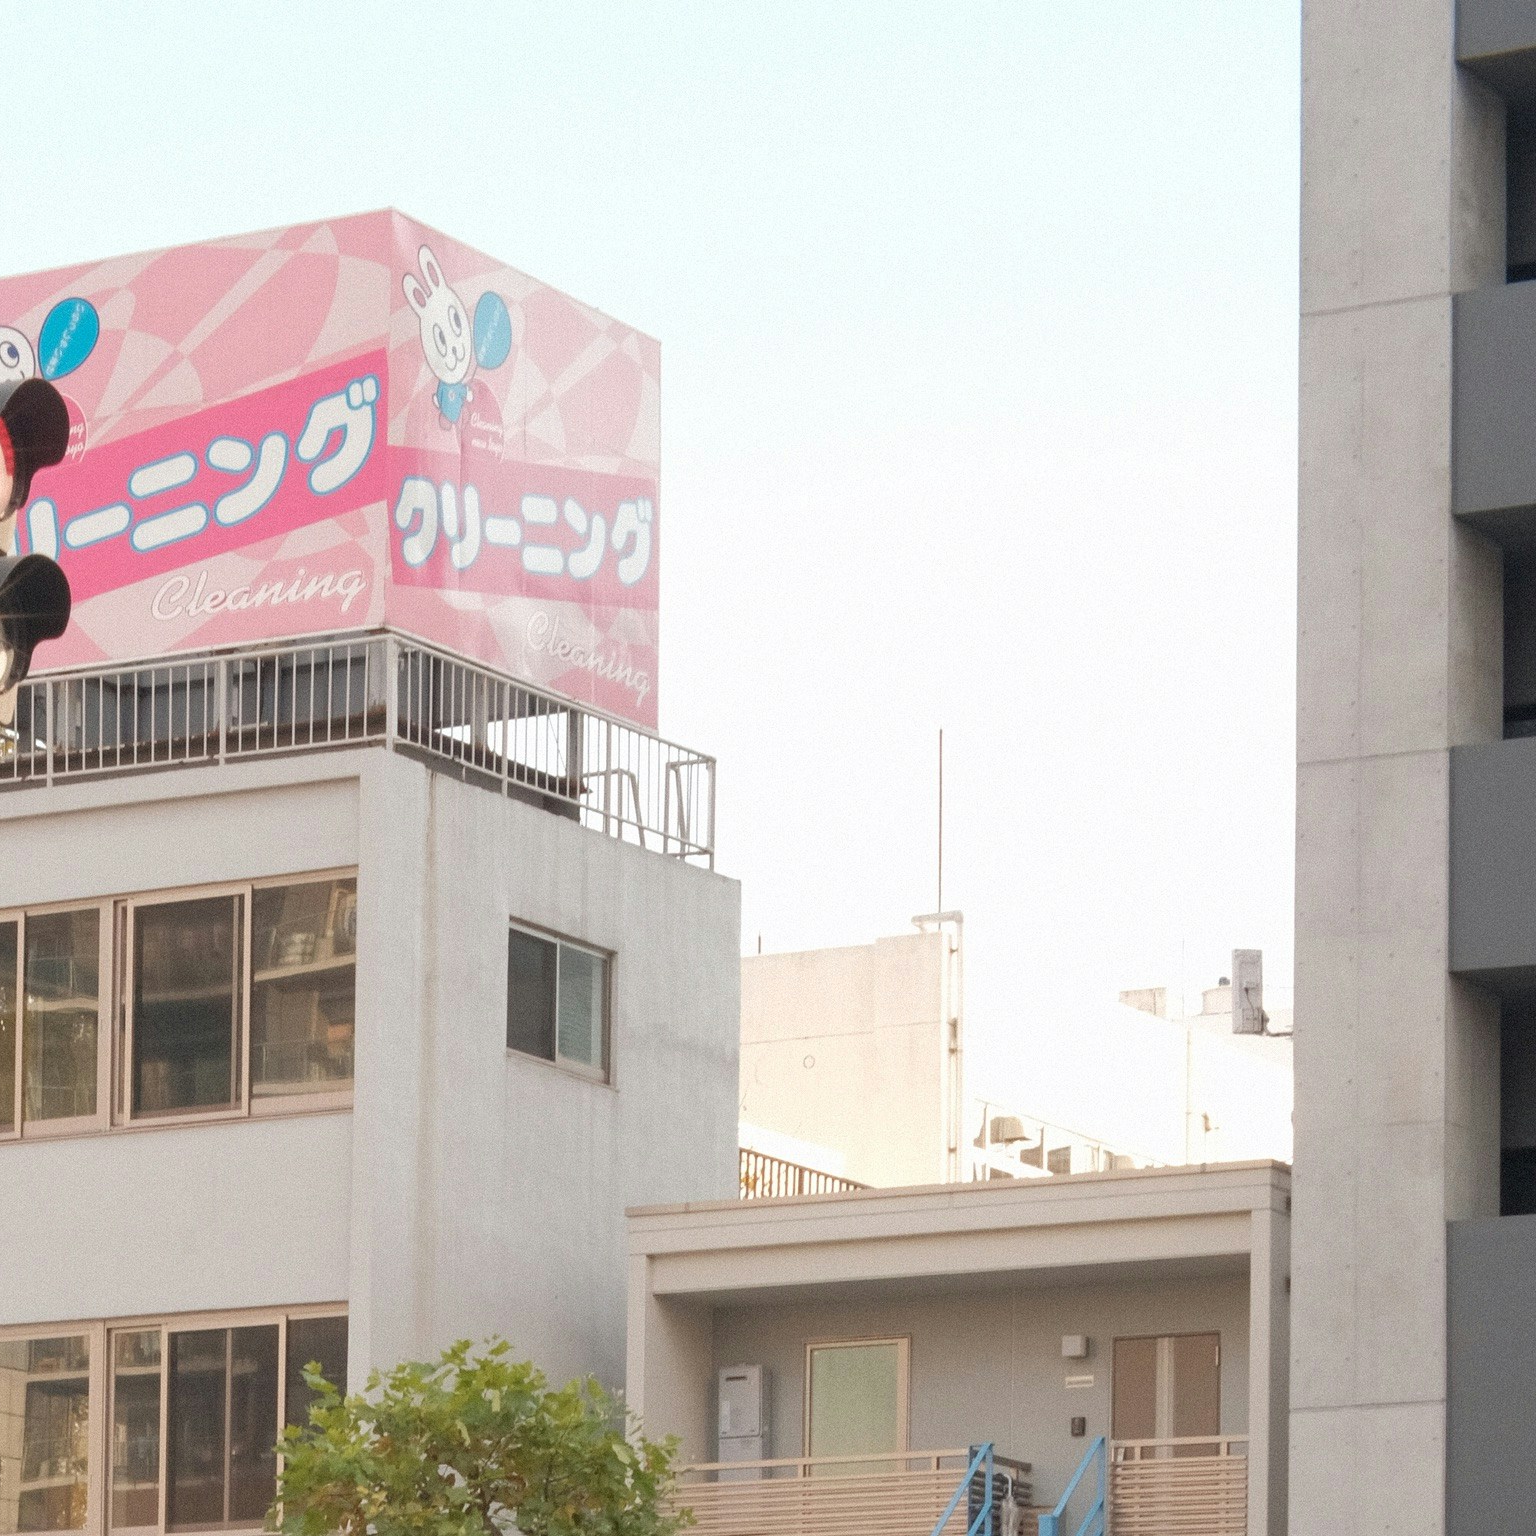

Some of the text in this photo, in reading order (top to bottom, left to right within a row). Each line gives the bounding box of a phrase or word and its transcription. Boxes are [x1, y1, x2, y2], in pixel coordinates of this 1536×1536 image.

[394, 475, 654, 588] クリーニング
[151, 568, 368, 622] Cleaning
[525, 610, 651, 708] Cleaning
